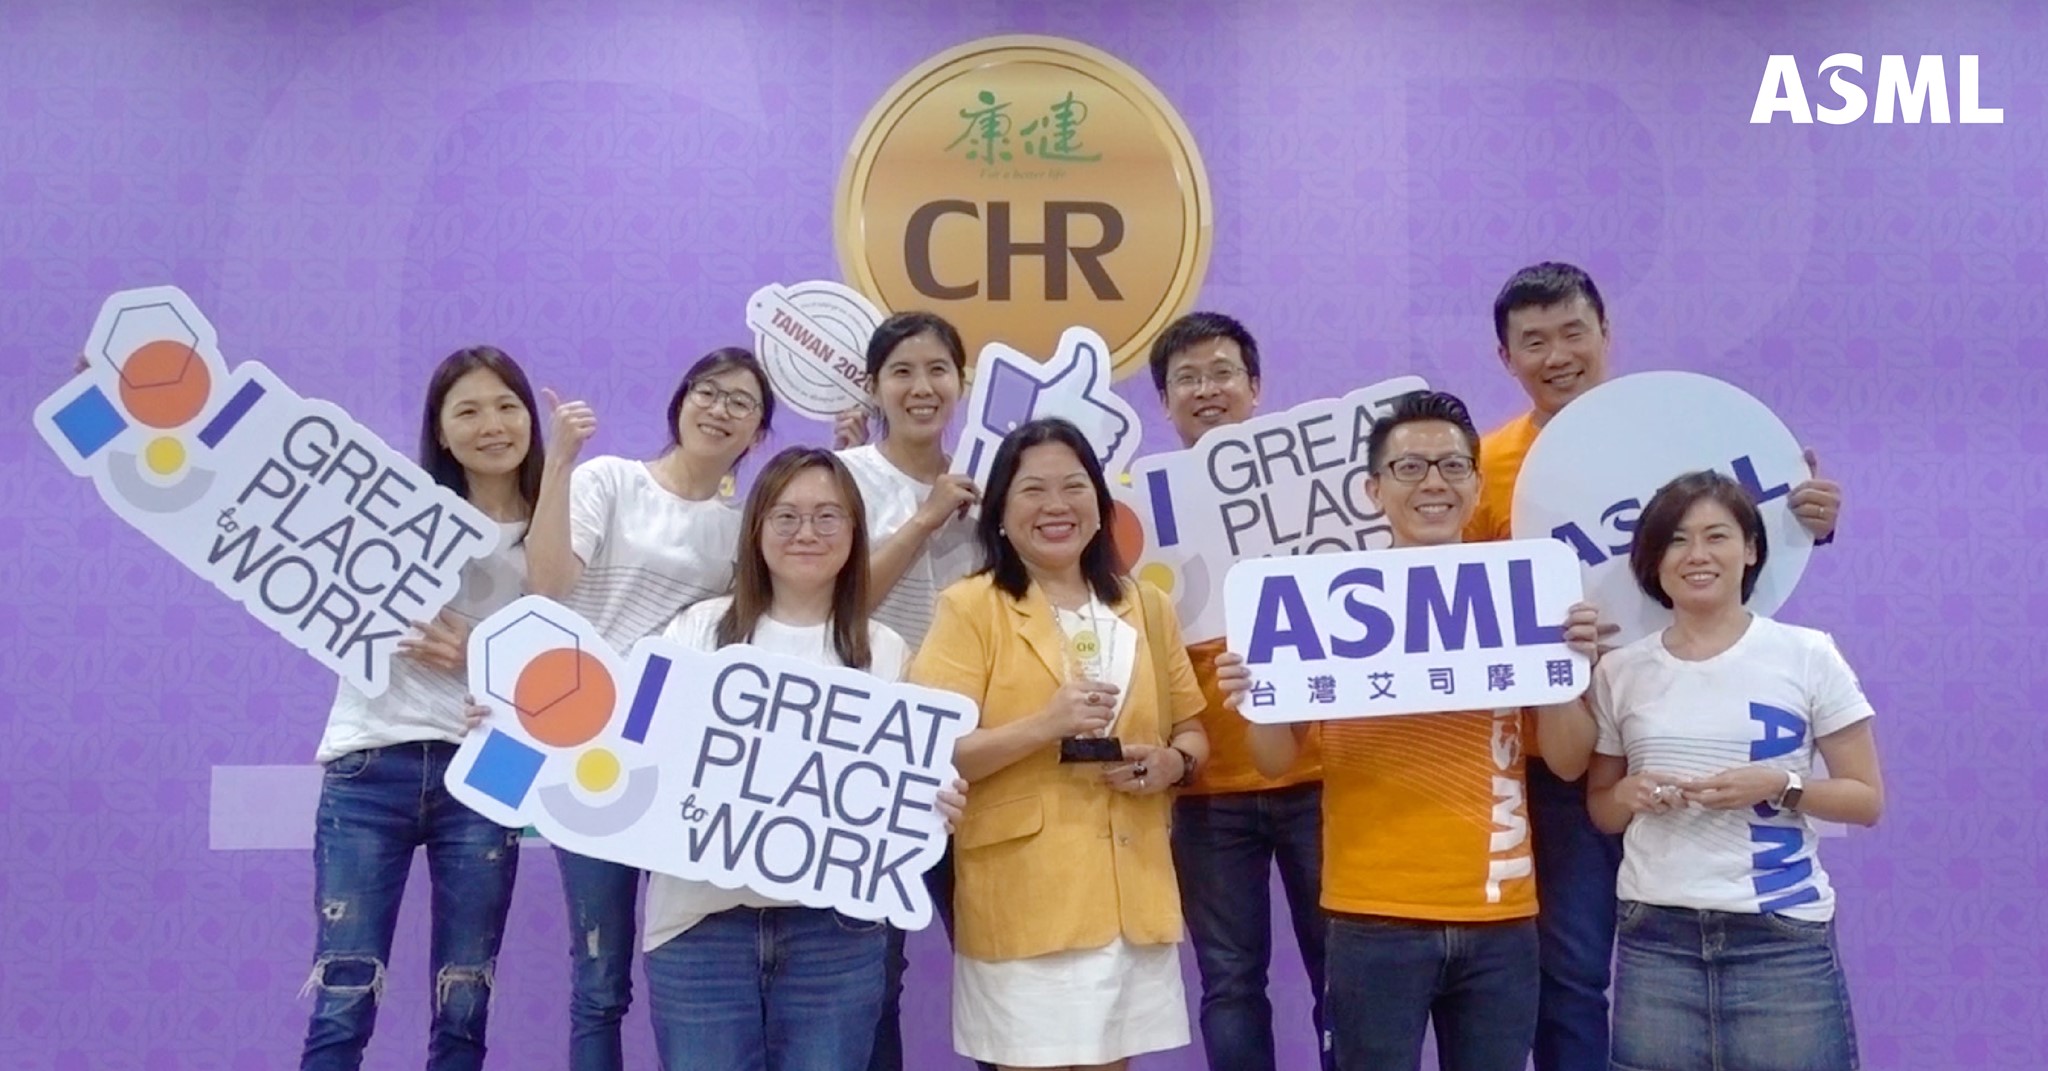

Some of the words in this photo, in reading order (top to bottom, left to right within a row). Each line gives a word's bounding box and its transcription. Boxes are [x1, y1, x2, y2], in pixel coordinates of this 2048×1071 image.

[944, 90, 1102, 165] 康健
[904, 199, 1125, 301] CHR
[770, 307, 835, 363] TAIWAN
[216, 507, 240, 533] to
[236, 458, 442, 628] PLACE
[283, 415, 484, 570] GREAT
[1219, 465, 1386, 556] PLAC
[1551, 455, 1791, 567] ASL
[207, 525, 403, 682] WORK
[1246, 559, 1567, 665] ASML
[712, 662, 962, 768] GREAT
[1250, 659, 1574, 707] 台灣艾司摩爾
[680, 794, 708, 822] to
[692, 726, 941, 841] PLACE
[1485, 708, 1533, 903] SML
[688, 803, 925, 913] WORK
